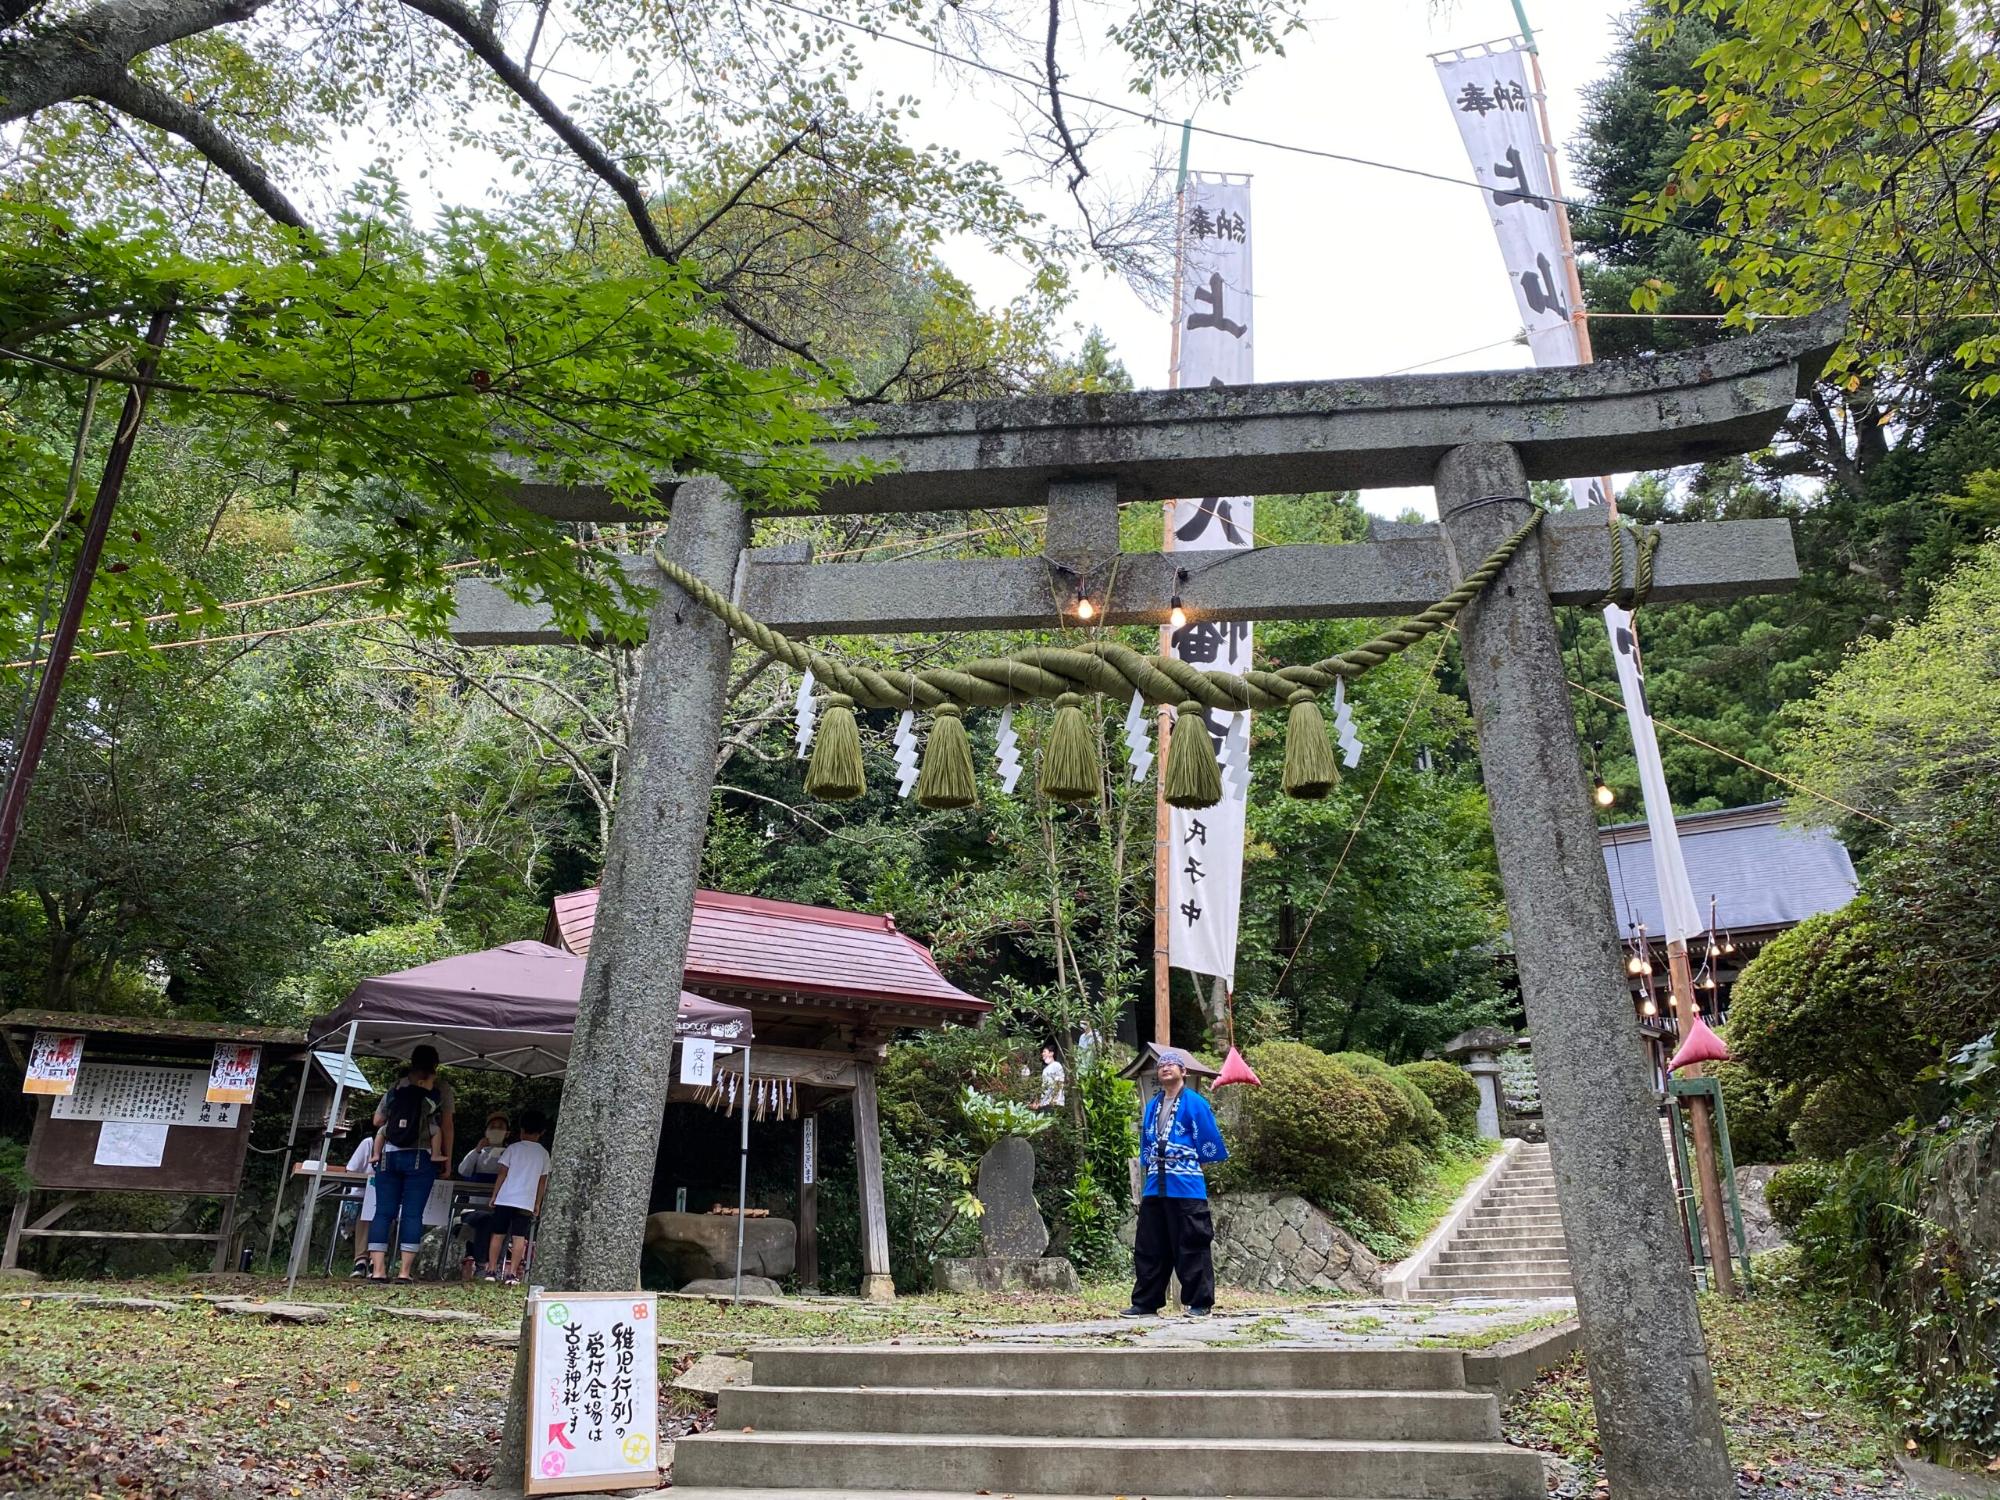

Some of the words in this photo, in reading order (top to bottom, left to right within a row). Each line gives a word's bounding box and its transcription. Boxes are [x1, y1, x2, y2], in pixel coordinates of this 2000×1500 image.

[693, 1047, 706, 1077] 受付
[562, 1322, 583, 1434] 古峯神社です
[584, 1332, 607, 1442] 受付会場は
[611, 1322, 635, 1439] 稚児行列の
